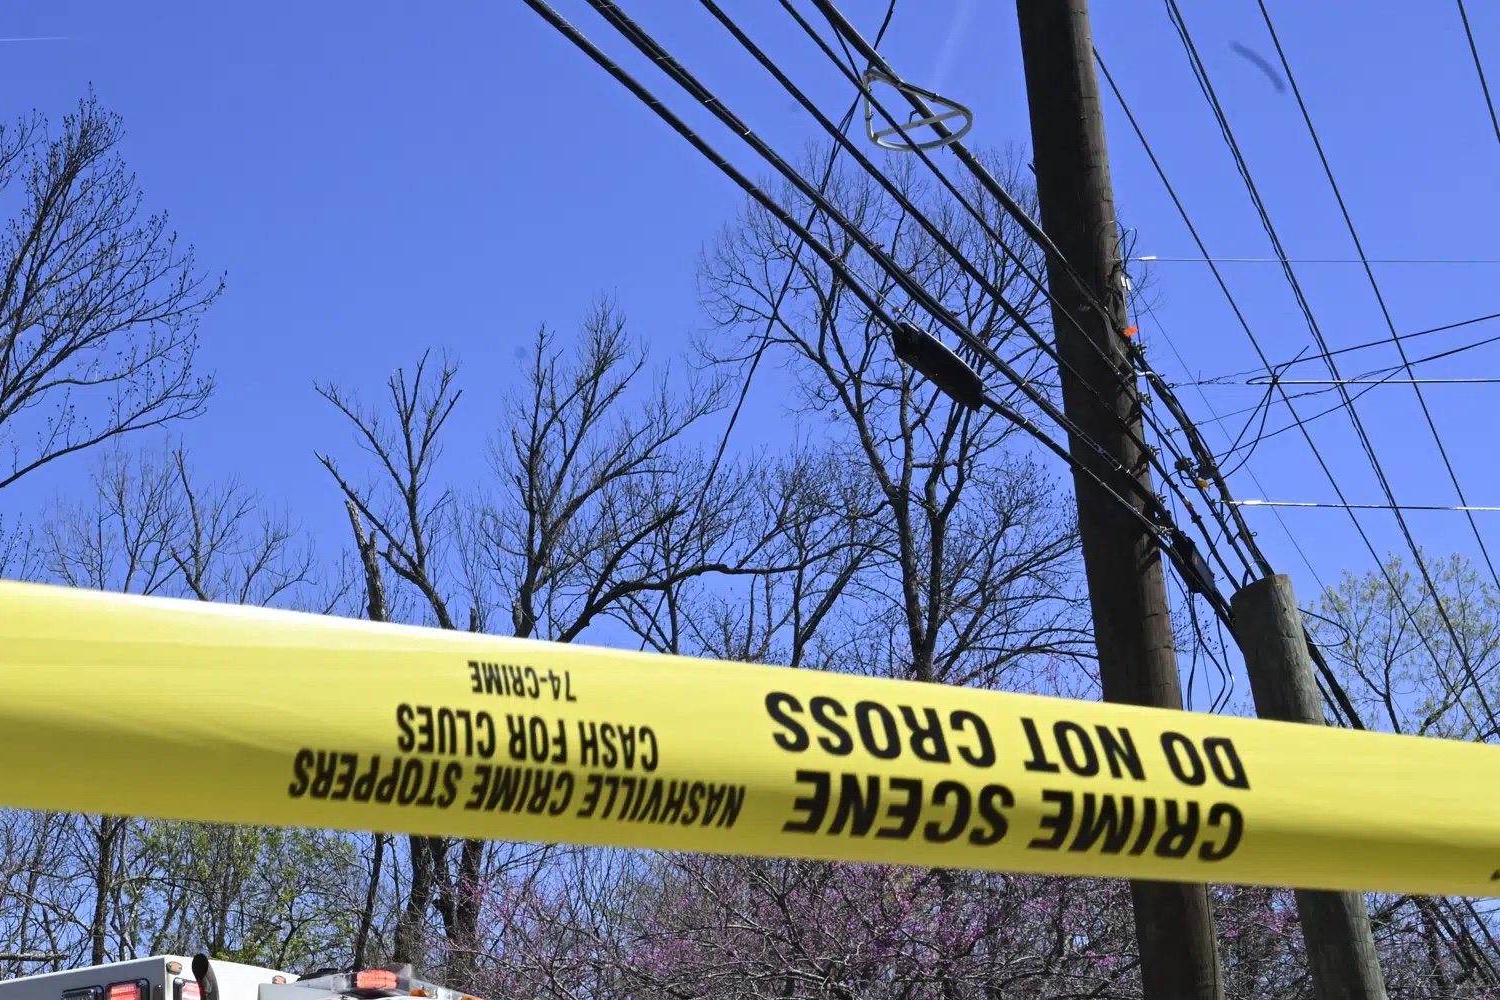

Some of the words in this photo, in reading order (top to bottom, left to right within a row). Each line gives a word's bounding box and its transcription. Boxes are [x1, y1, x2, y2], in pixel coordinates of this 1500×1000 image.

[467, 660, 577, 703] 74-CRIME
[396, 703, 497, 760] CLUES
[506, 714, 568, 765] FOR
[578, 720, 659, 773] CASH
[764, 691, 997, 769] CROSS
[1020, 717, 1147, 787] NOT
[288, 747, 463, 810] STOPPERS
[1159, 731, 1251, 791] DO
[463, 764, 576, 817] CRIME
[577, 773, 746, 829] NASHVILLE
[781, 769, 1015, 847] SCENE
[1026, 789, 1245, 863] CRIME
